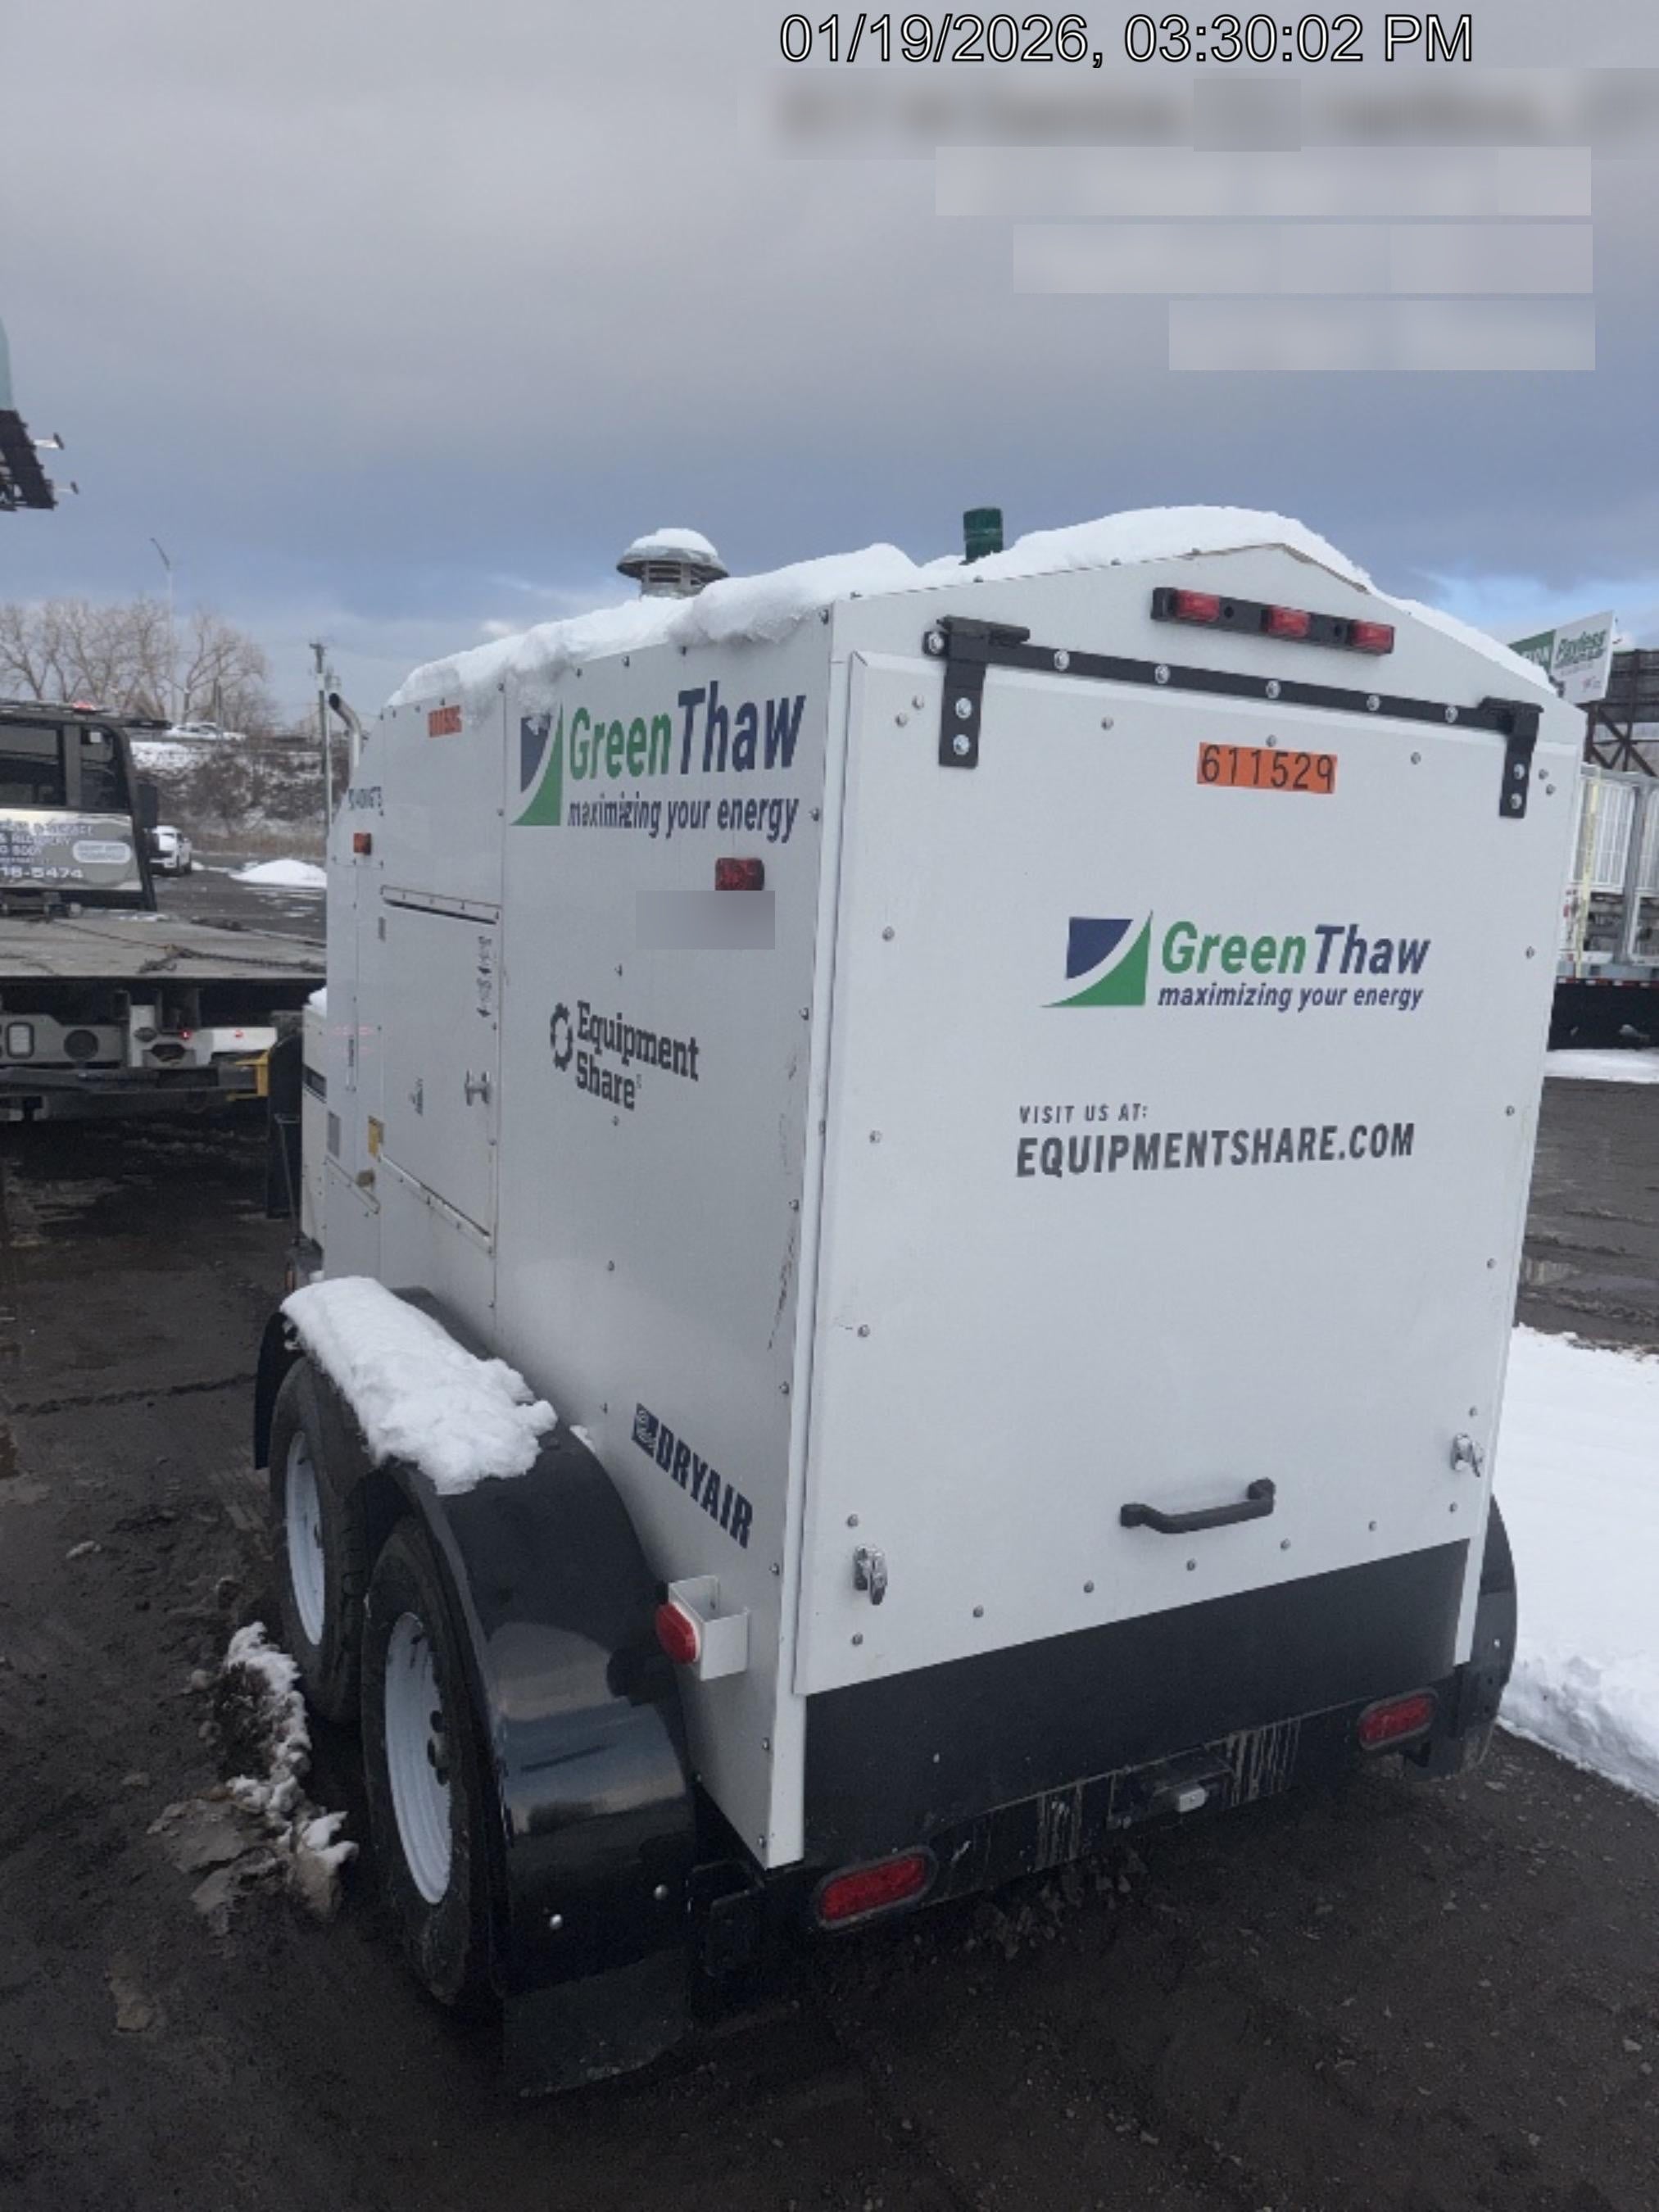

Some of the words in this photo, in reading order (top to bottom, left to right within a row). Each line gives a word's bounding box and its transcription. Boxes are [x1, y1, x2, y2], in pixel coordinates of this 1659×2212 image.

[1201, 744, 1334, 791] 611529
[567, 791, 662, 839] maximizing
[665, 799, 711, 840] your
[717, 797, 800, 844] energy
[1157, 981, 1292, 1013] maximizing
[1297, 986, 1348, 1013] your
[1353, 986, 1424, 1012] energy
[576, 999, 700, 1082] Equipment
[575, 1049, 636, 1112] Share
[1019, 1104, 1075, 1125] VISIT
[1084, 1104, 1109, 1122] US
[1117, 1103, 1149, 1122] AT:
[1016, 1122, 1415, 1178] EQUIPMENTSHARE.COM
[655, 1422, 753, 1549] DRYAIR
